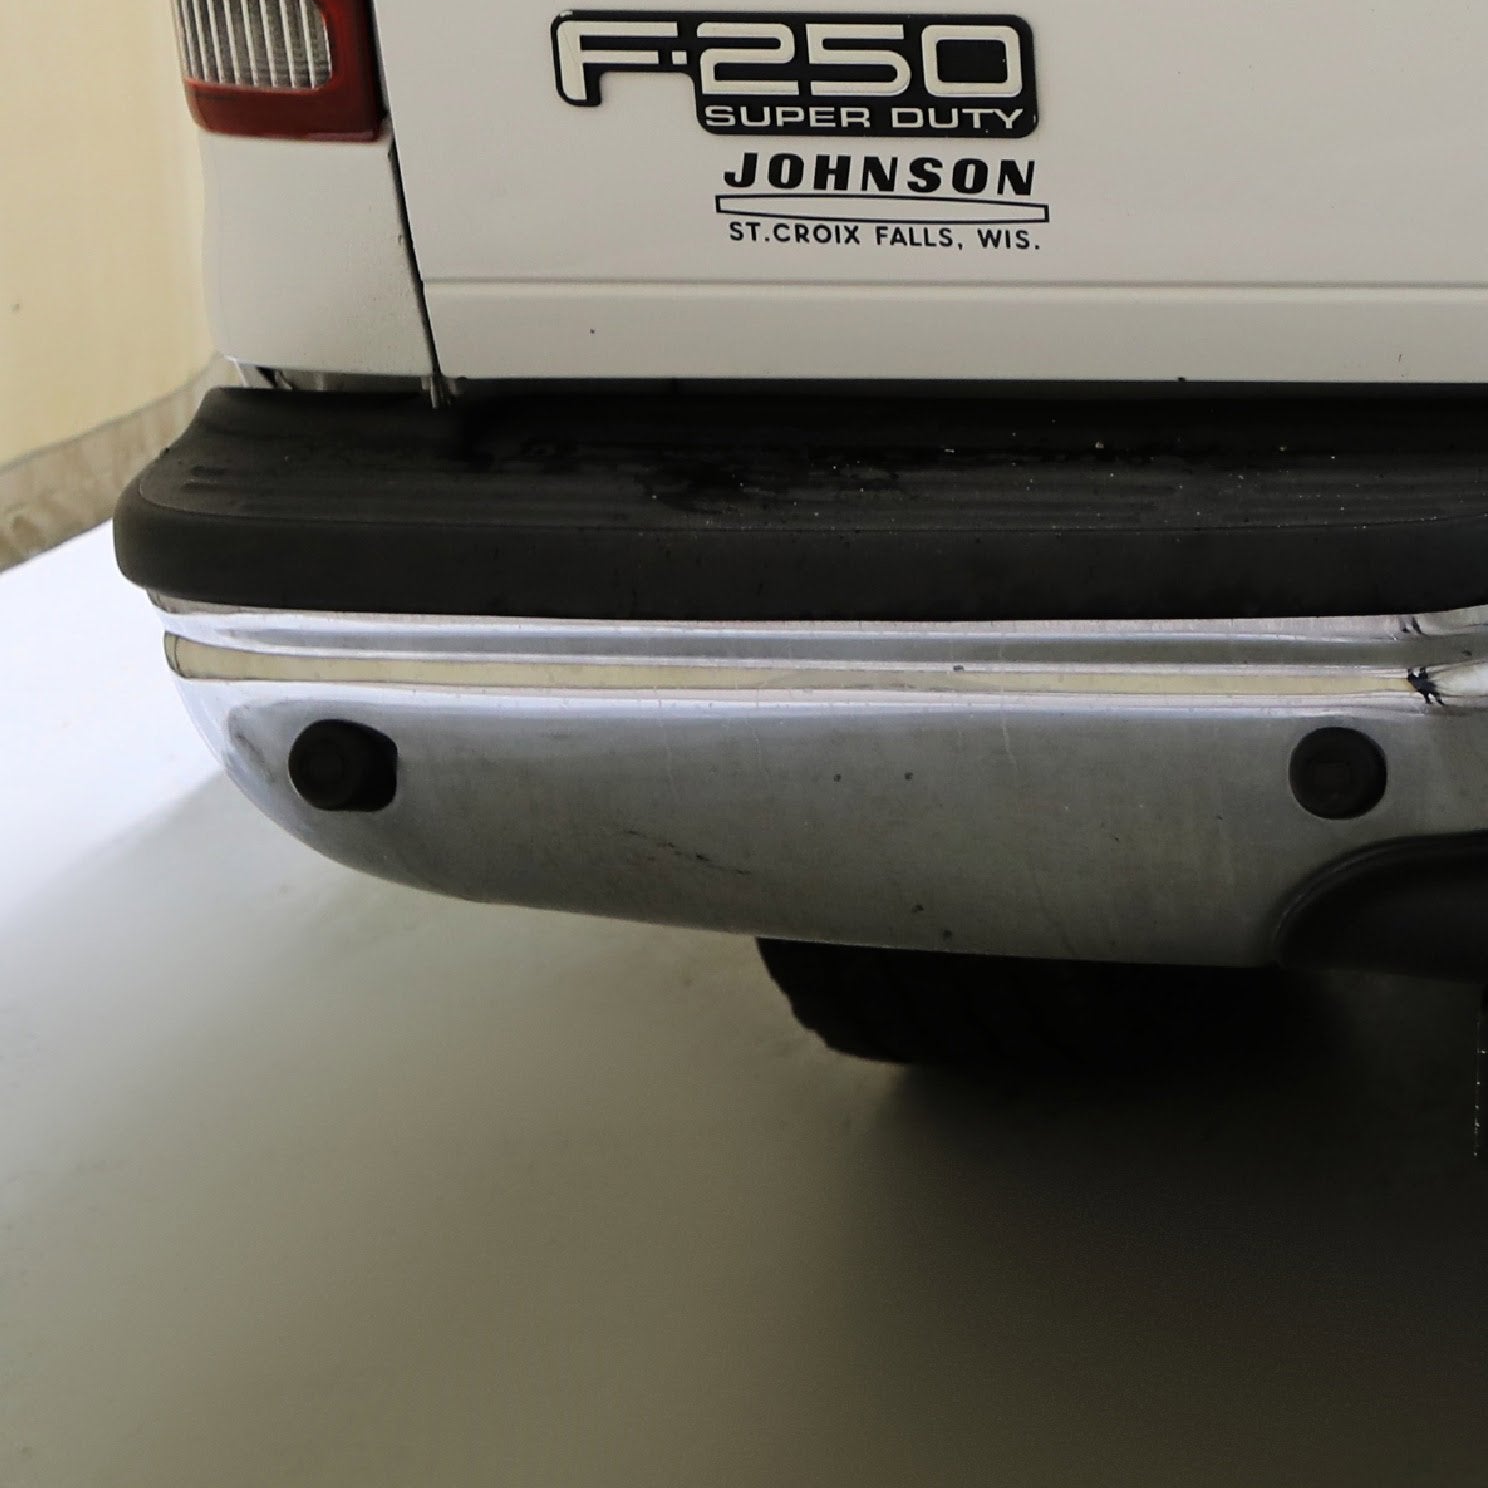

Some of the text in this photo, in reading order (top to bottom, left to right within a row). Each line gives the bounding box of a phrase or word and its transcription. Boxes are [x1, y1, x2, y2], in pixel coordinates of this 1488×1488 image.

[705, 106, 1023, 129] SUPER DUTY
[724, 153, 1034, 196] JOHNSON
[977, 229, 1041, 250] WIS.
